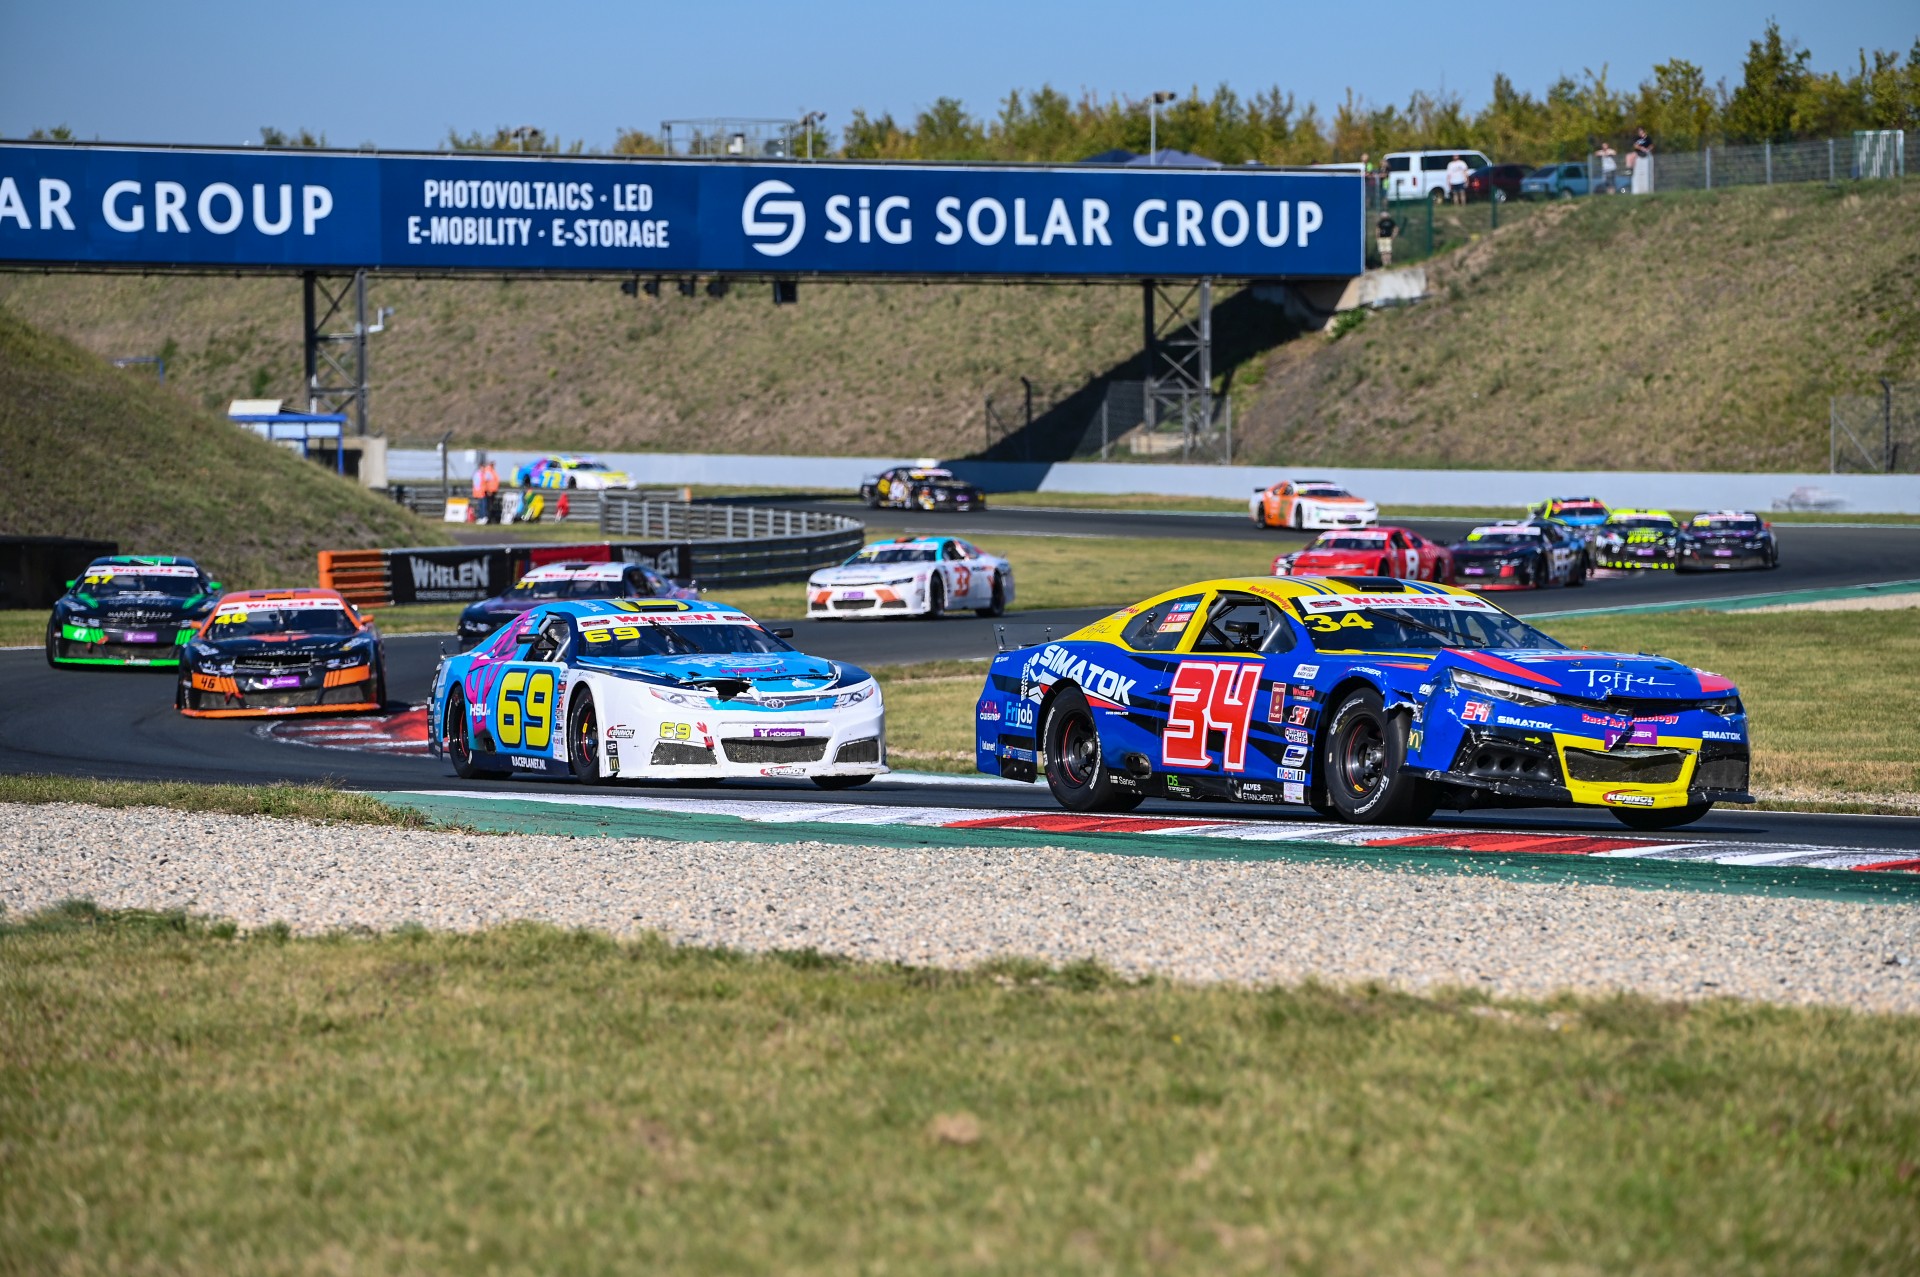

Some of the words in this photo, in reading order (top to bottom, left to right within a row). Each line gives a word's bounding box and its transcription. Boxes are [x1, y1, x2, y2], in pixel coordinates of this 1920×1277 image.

[424, 180, 593, 211] PHOTOVOLTAICS
[613, 184, 653, 213] LED
[102, 181, 334, 236] GROUP
[408, 215, 531, 246] E-MOBILITY
[552, 219, 669, 249] E-STORAGE
[935, 197, 1112, 247] SOLAR
[1133, 199, 1324, 248] GROUP
[409, 555, 490, 589] WHELEN
[1343, 596, 1451, 606] WHELEN
[614, 613, 717, 624] WHELEN
[1303, 613, 1375, 632] 34
[583, 627, 641, 643] 69
[201, 678, 216, 689] 46
[1039, 645, 1137, 706] SIMATOK
[497, 669, 554, 750] 69
[1005, 701, 1033, 728] Frijob
[1163, 660, 1265, 772] 34
[1461, 701, 1491, 722] 34
[660, 722, 691, 741] 69
[1497, 715, 1554, 729] SIMATOK
[1609, 717, 1627, 730] Art
[1702, 731, 1741, 741] SIMATOK
[1167, 775, 1179, 786] DS
[1279, 768, 1296, 781] Mobil
[1243, 783, 1261, 791] ALVES
[1606, 793, 1655, 804] KENNOL
